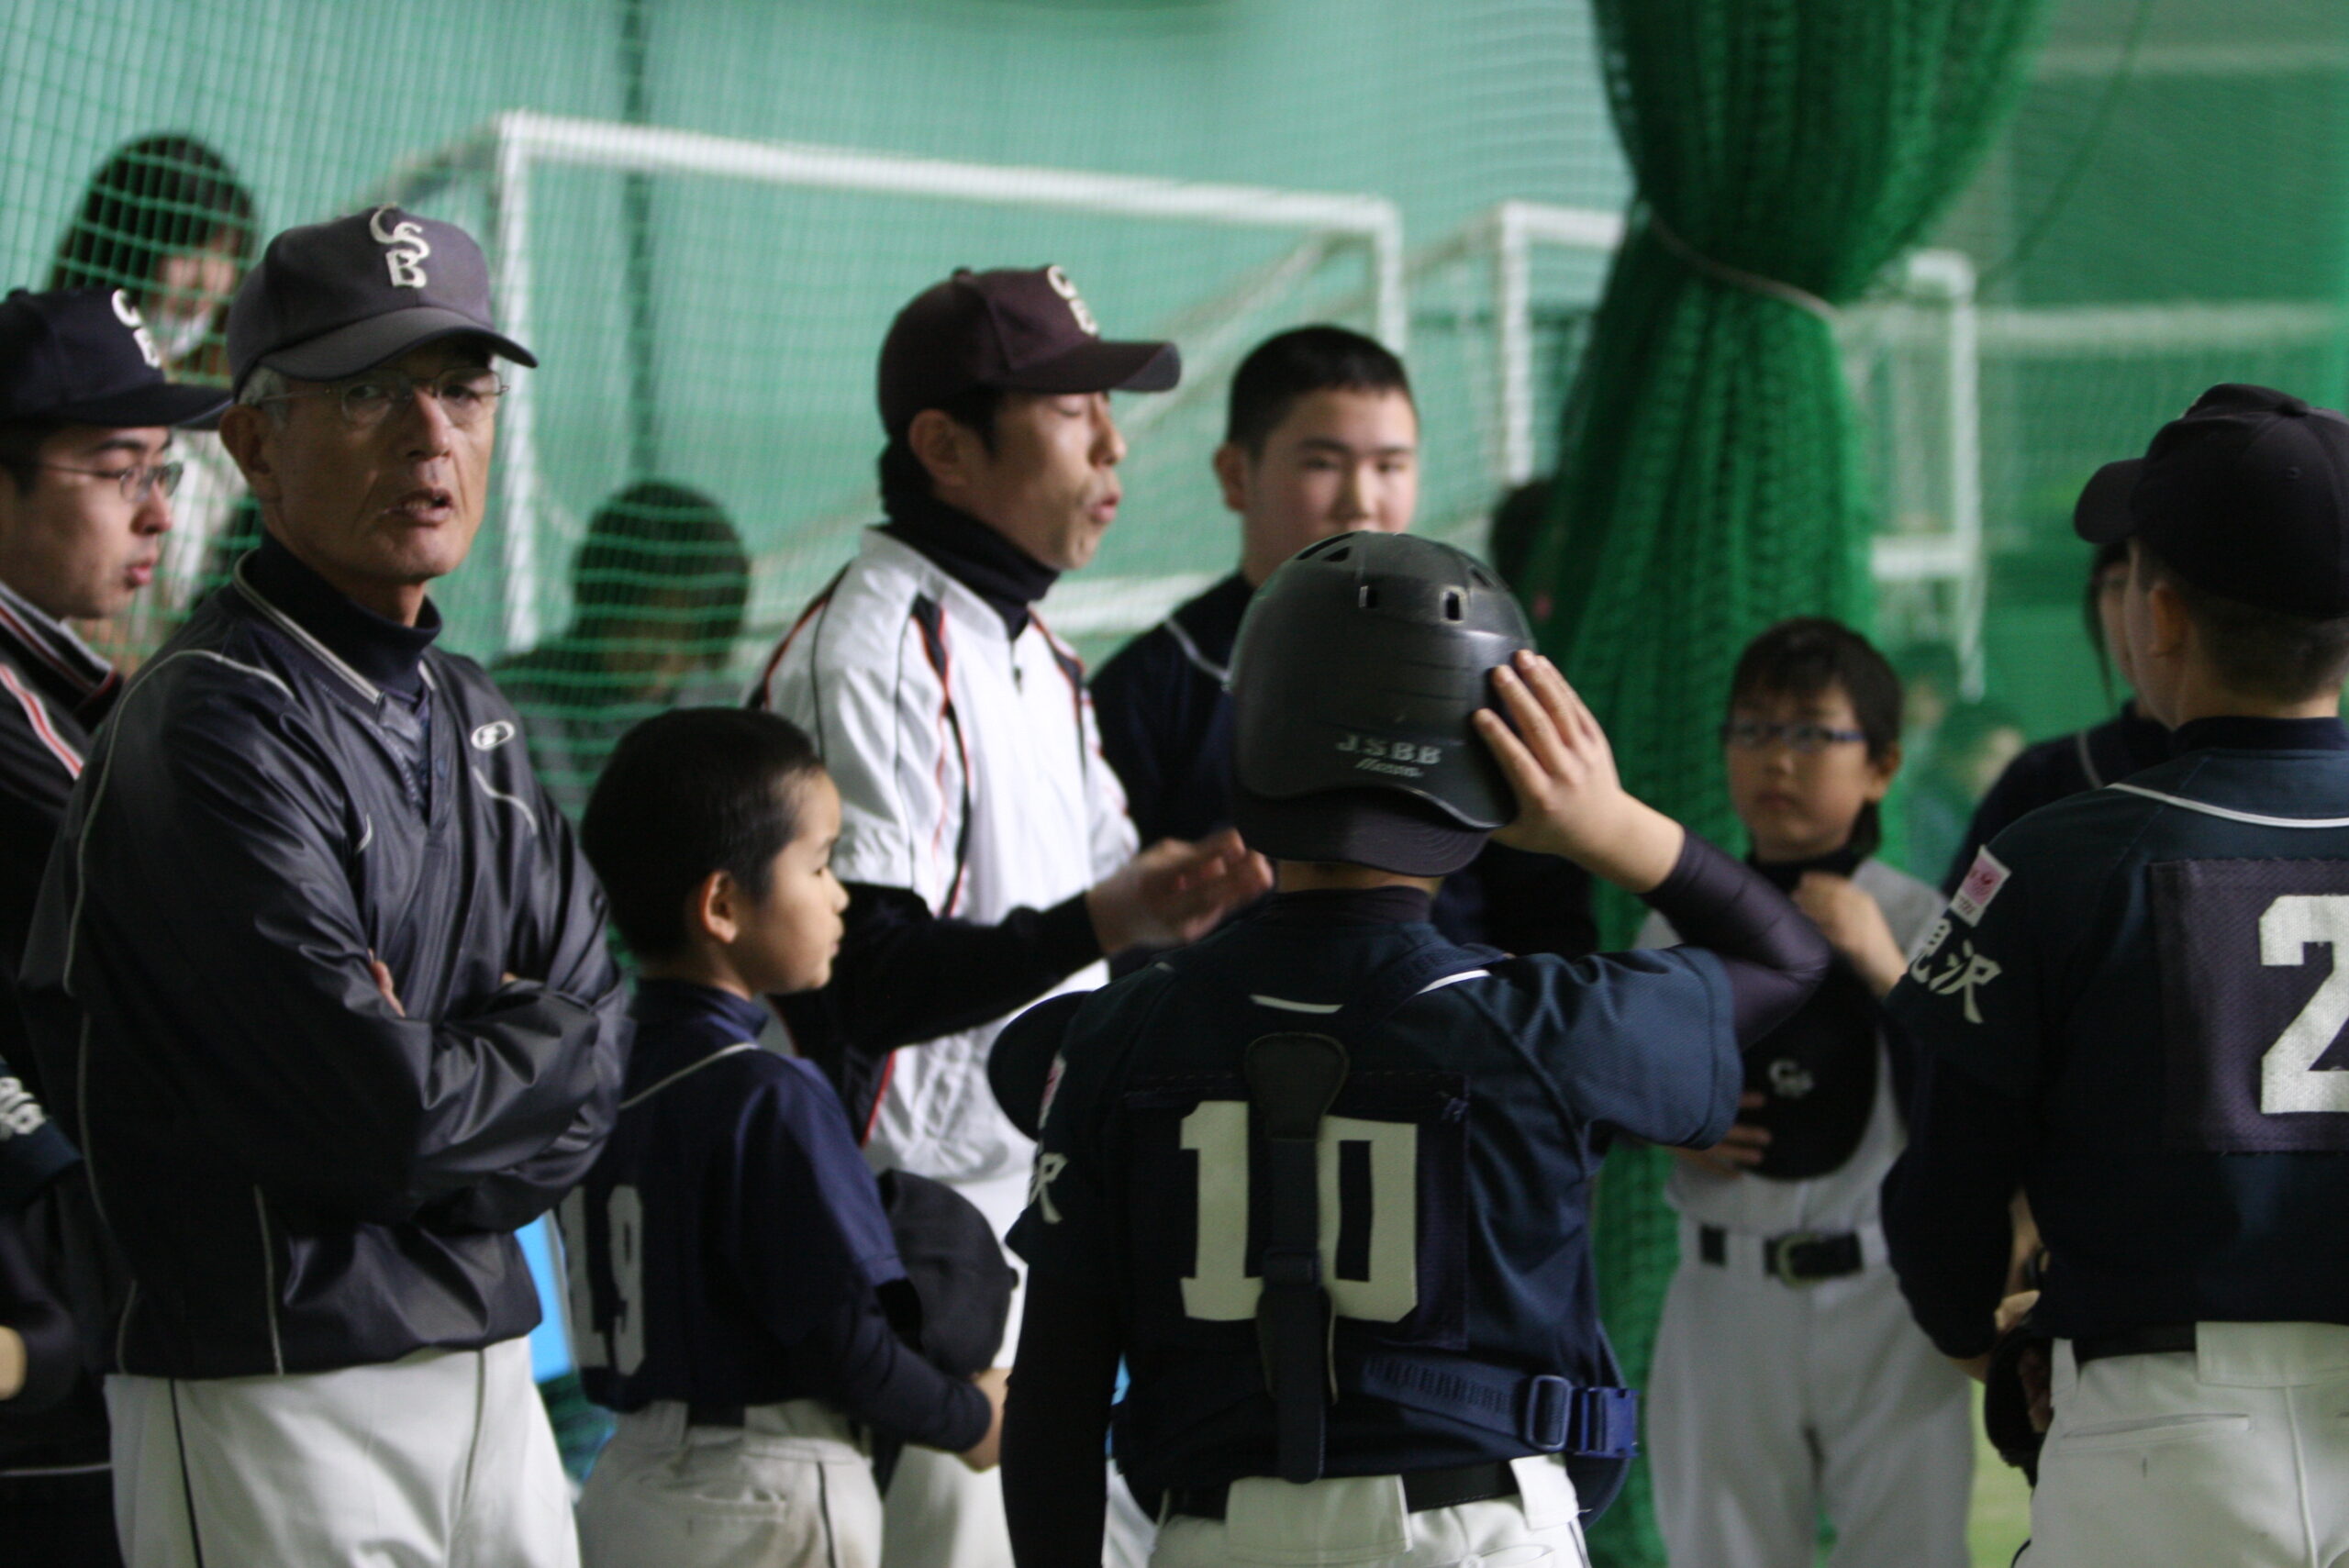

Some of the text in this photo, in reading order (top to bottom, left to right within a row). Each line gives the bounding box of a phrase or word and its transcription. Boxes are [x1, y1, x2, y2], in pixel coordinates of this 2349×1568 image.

[2259, 895, 2349, 1114] 2
[560, 1184, 645, 1376] 19
[1180, 1101, 1418, 1323] 10
